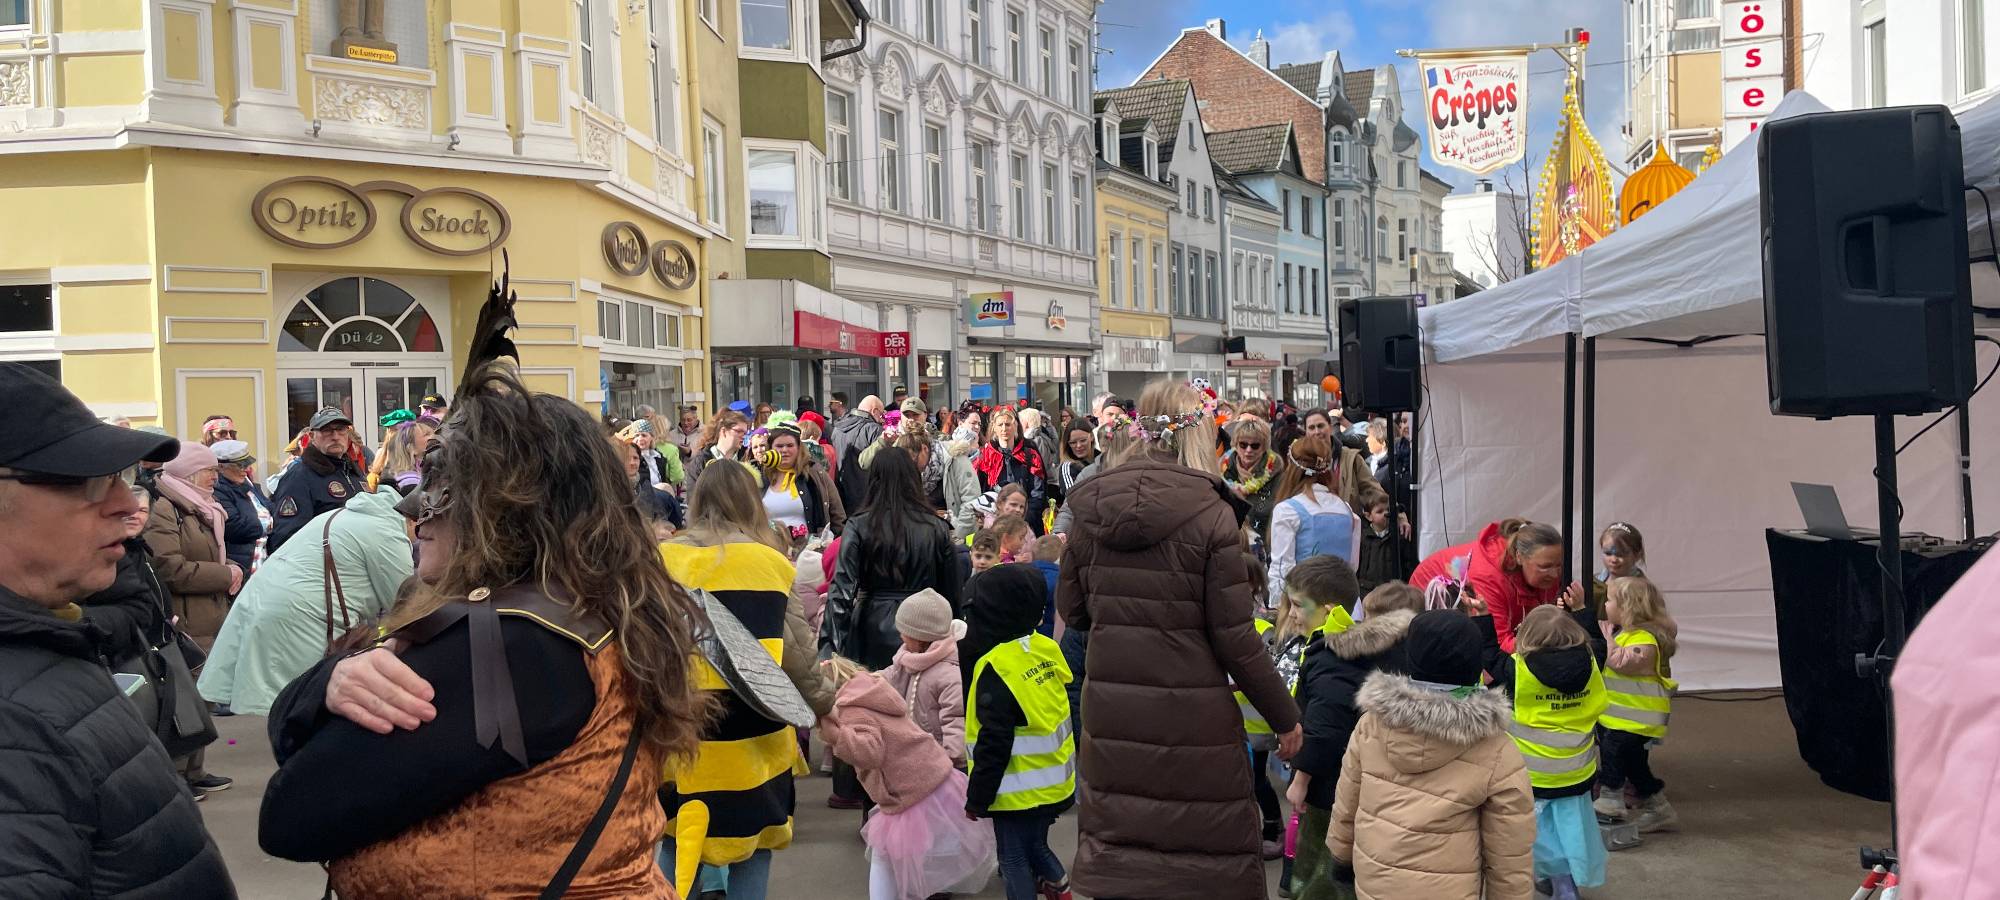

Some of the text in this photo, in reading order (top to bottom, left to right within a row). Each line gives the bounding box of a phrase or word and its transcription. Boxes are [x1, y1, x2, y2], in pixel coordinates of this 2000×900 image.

[1452, 64, 1518, 82] Französische
[1431, 79, 1518, 130] Crêpes
[1467, 136, 1506, 154] herzhaft,
[1469, 142, 1516, 164] beschwipst!
[268, 197, 490, 236] Optik Stock
[982, 298, 1005, 313] dm
[1050, 299, 1065, 318] dm
[341, 331, 383, 345] Dü 42
[884, 333, 906, 347] DER
[886, 347, 906, 356] TOUR
